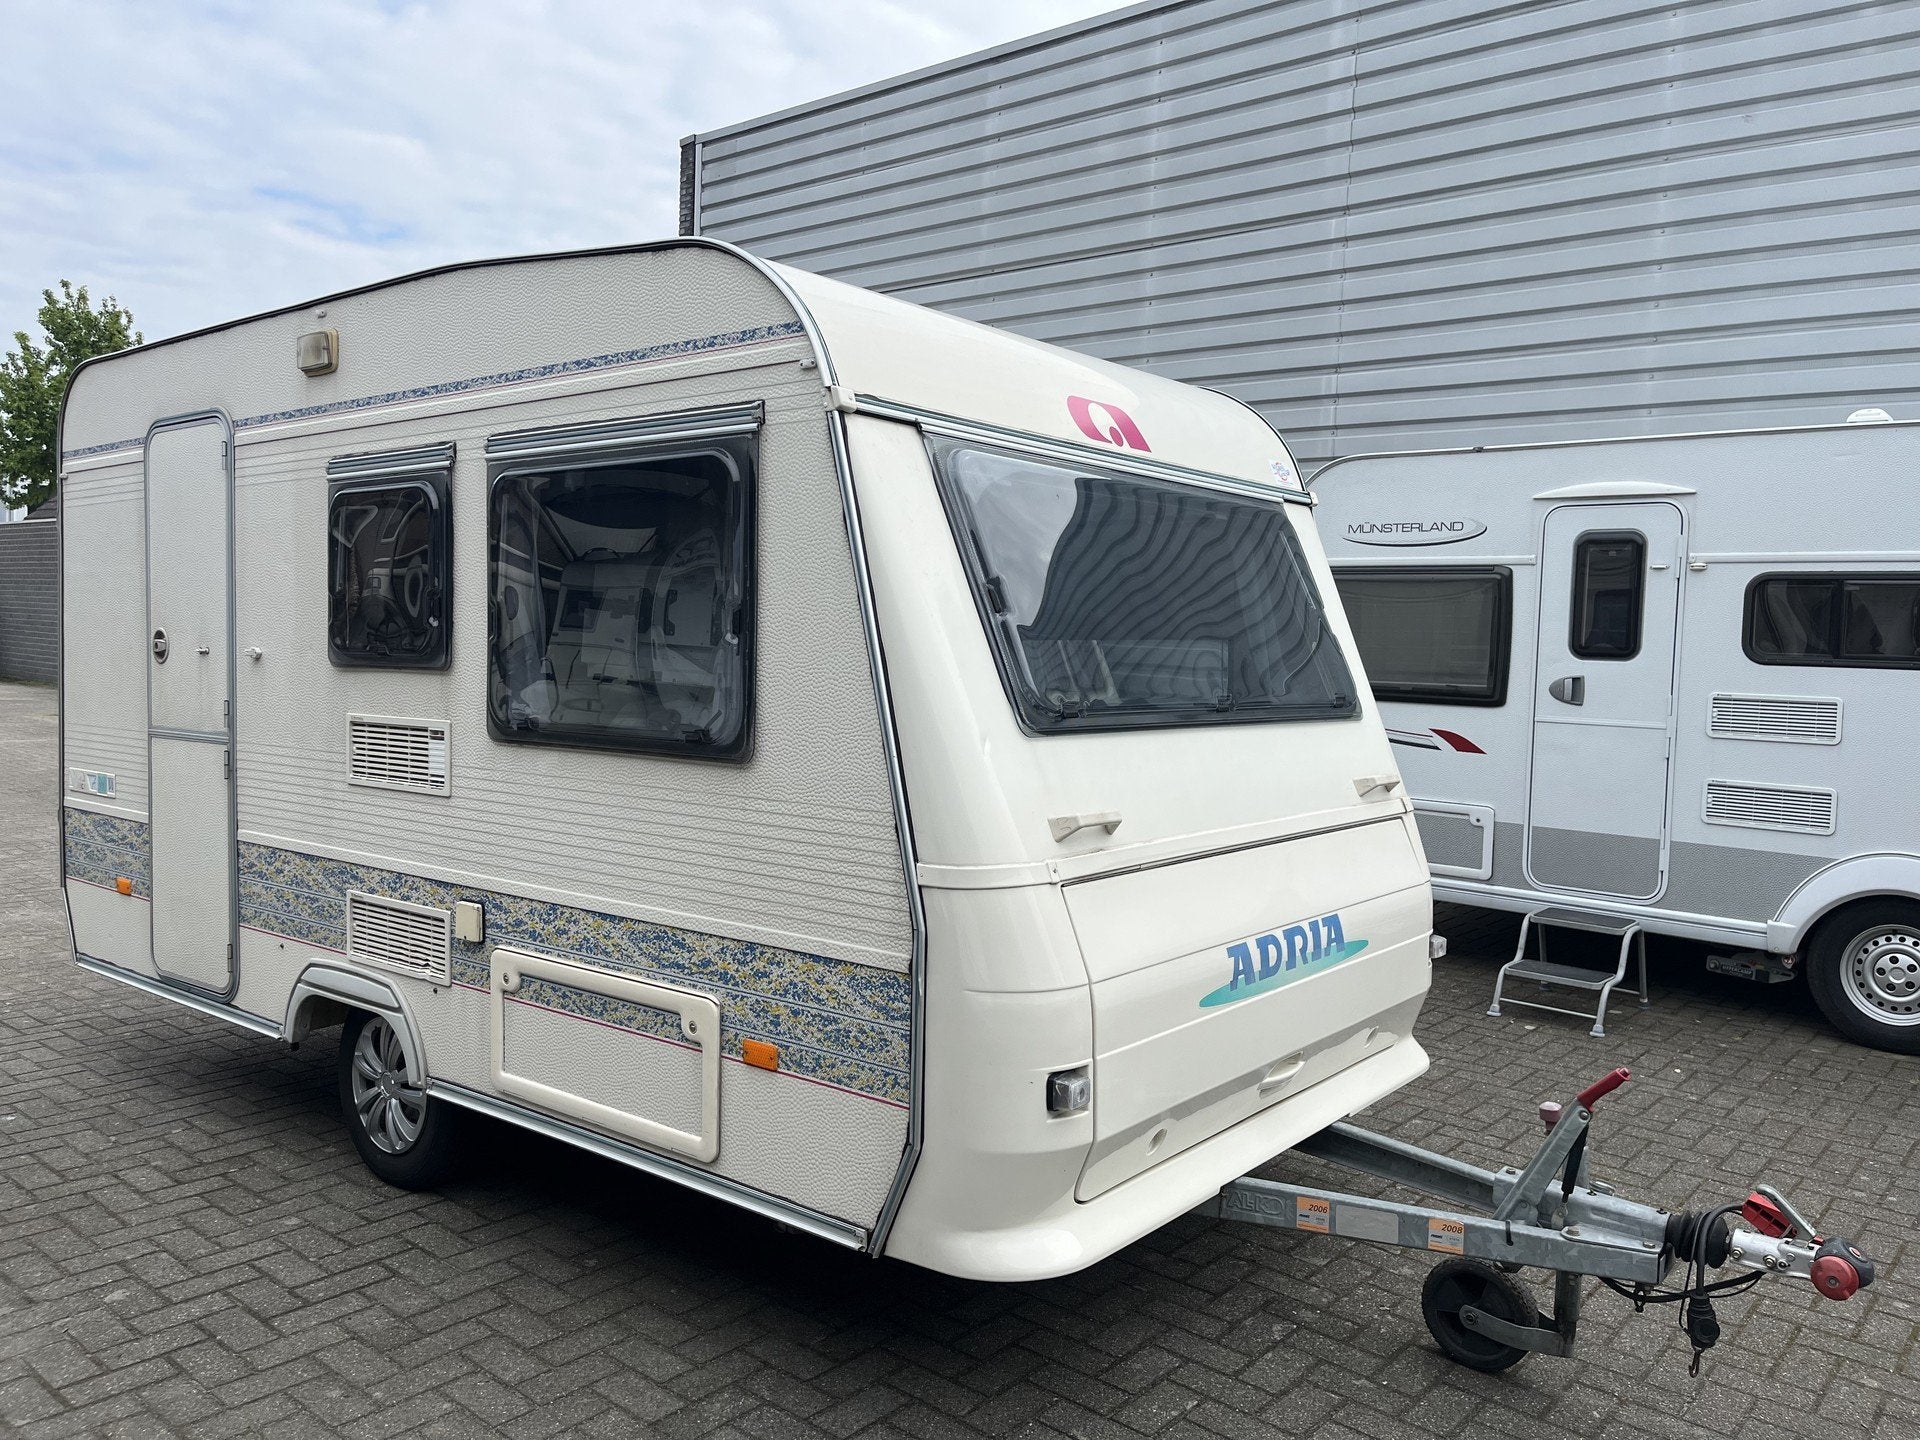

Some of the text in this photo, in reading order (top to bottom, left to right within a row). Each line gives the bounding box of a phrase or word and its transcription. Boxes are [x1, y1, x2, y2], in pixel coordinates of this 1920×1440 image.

[1348, 521, 1464, 534] MÜNSTERLAND
[1226, 913, 1346, 991] ADRIA
[1309, 1204, 1329, 1214] 2006
[1441, 1223, 1464, 1234] 2008
